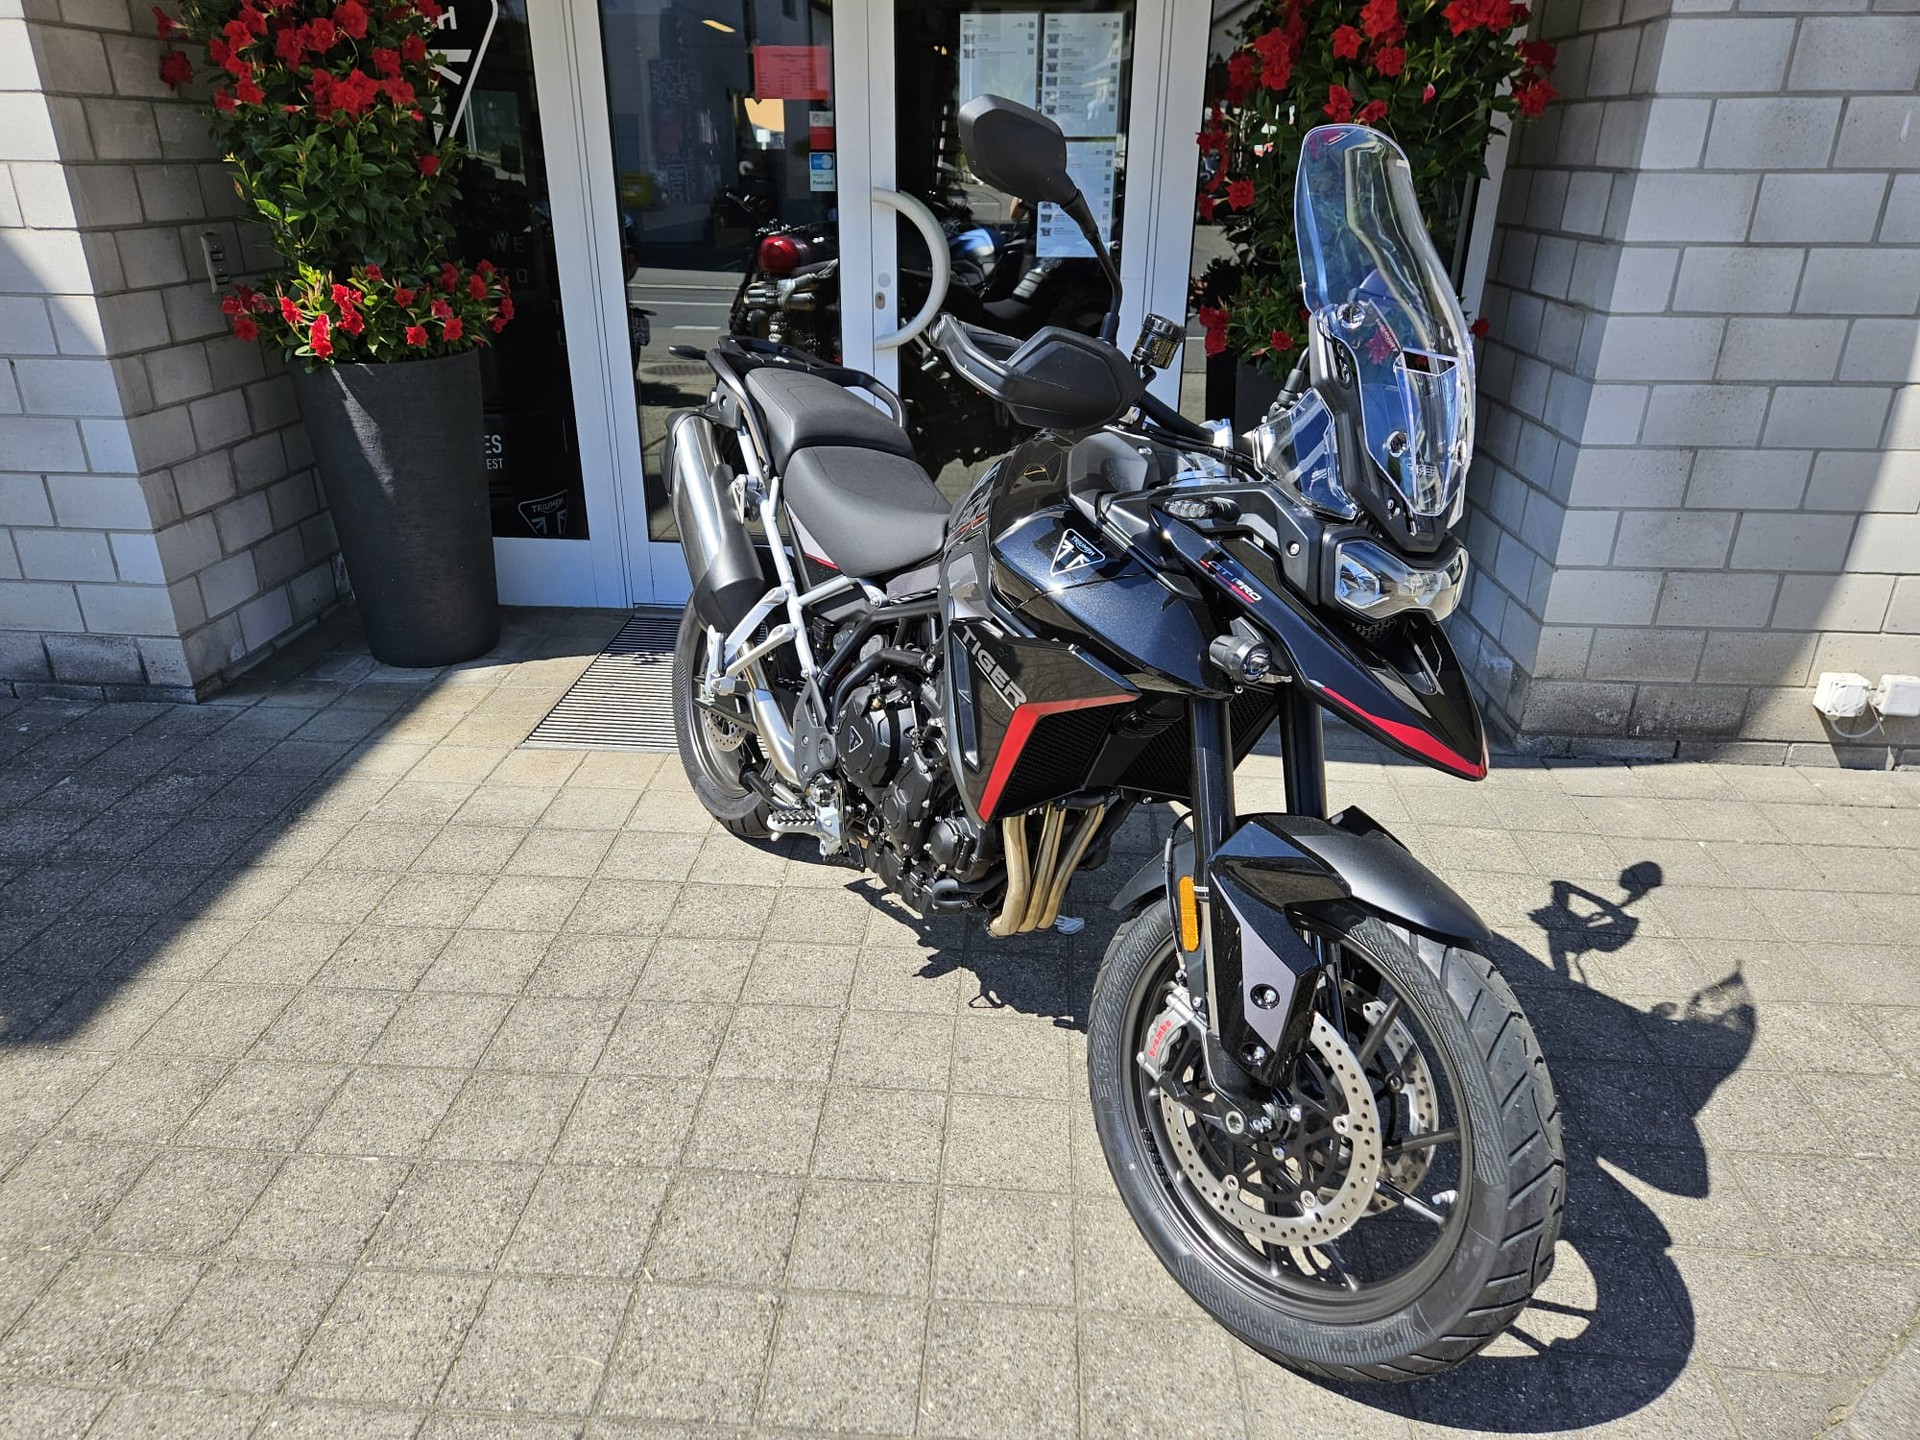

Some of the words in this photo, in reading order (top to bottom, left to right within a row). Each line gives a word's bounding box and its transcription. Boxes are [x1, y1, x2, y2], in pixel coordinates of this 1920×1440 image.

[1071, 535, 1096, 557] TRIUMPH
[1207, 560, 1234, 576] GT
[1231, 577, 1263, 601] PRO
[962, 625, 1027, 708] TIGER
[1147, 1019, 1173, 1060] brembo
